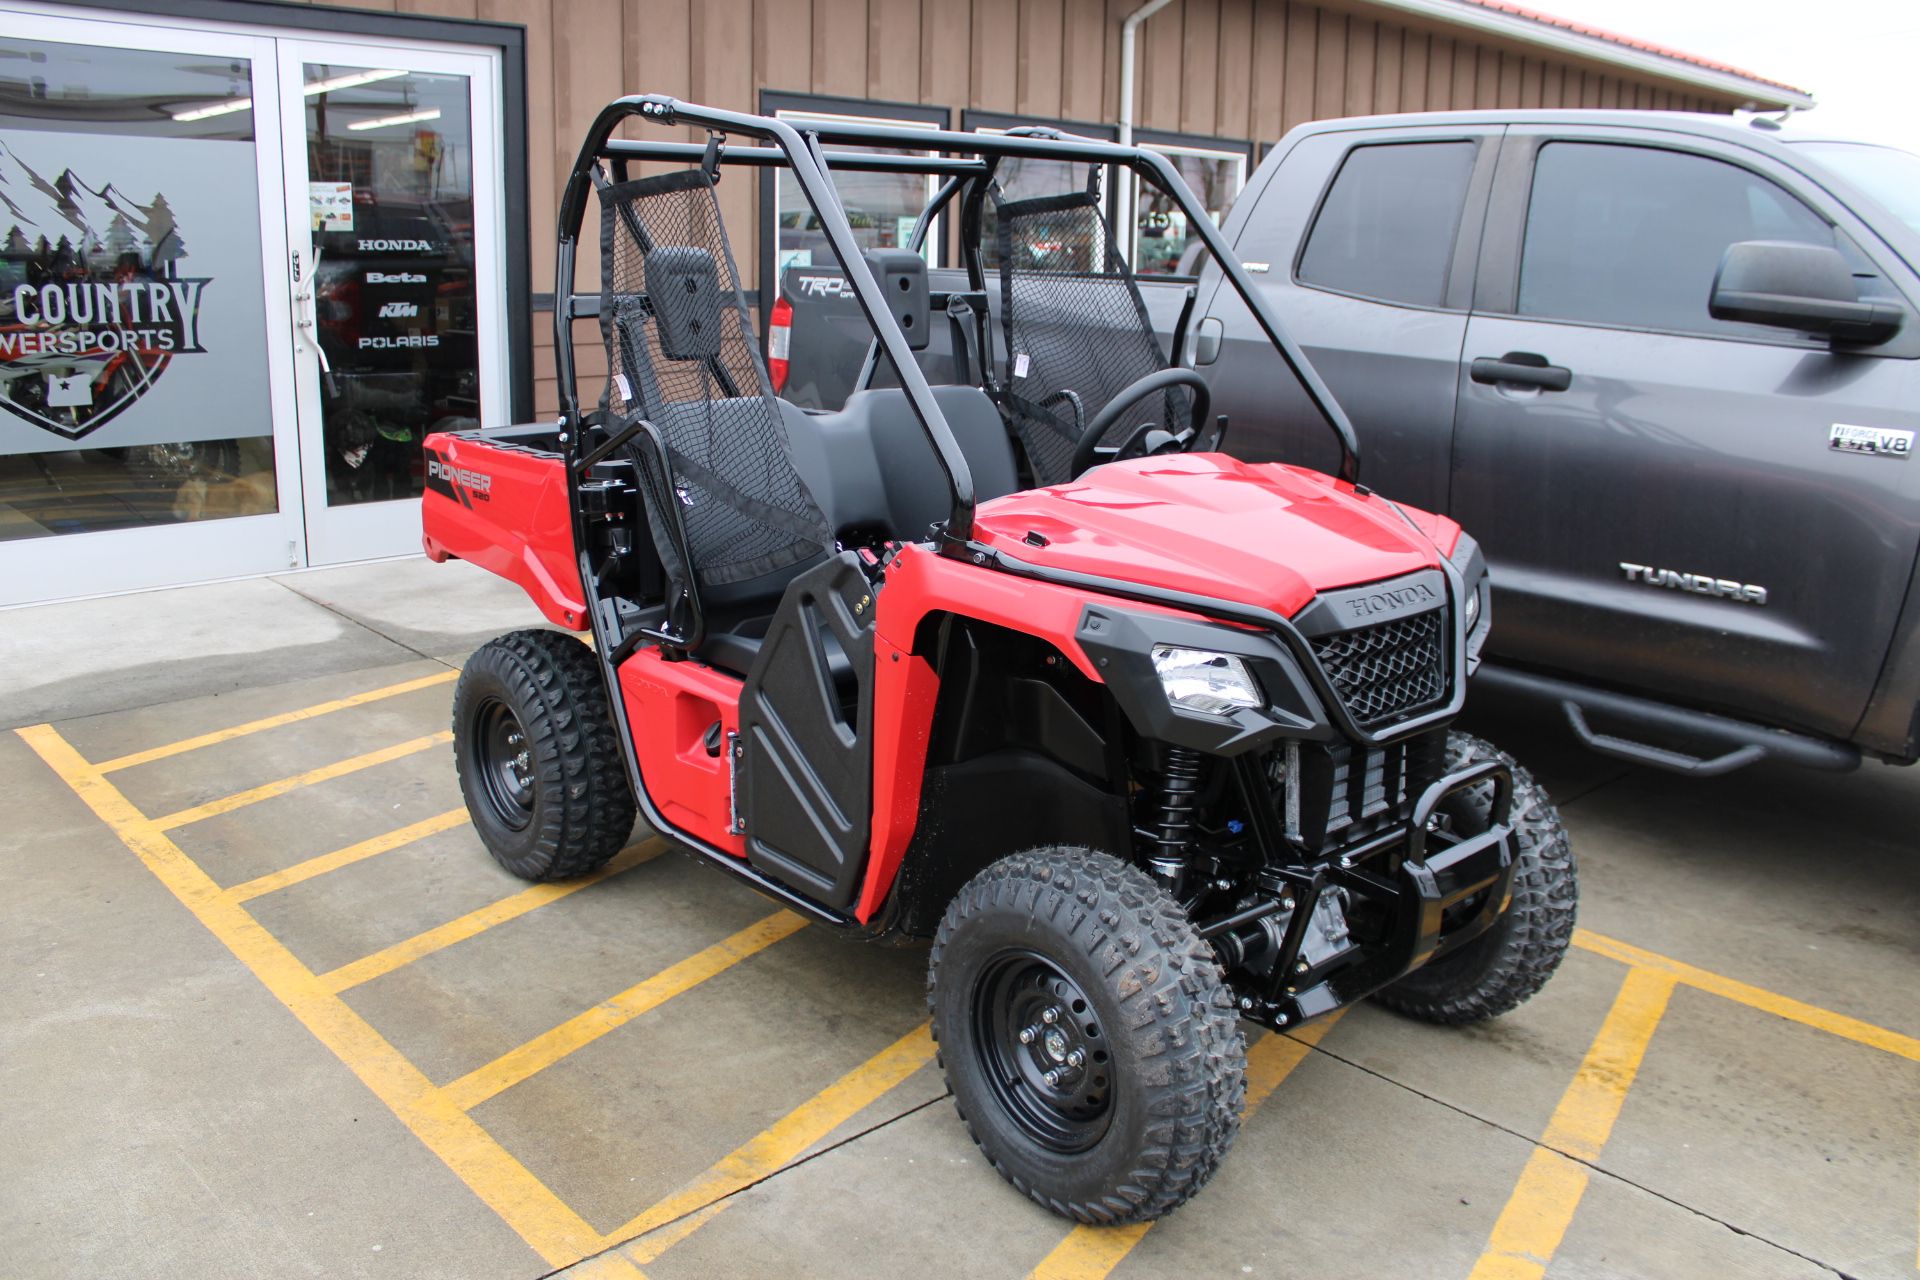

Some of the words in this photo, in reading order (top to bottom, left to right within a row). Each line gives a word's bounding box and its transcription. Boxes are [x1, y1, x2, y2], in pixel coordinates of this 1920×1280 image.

[357, 239, 432, 251] HONDA
[366, 272, 427, 283] Beta
[799, 276, 844, 297] TRD
[14, 281, 201, 350] COUNTRY
[378, 302, 418, 317] KTM
[358, 335, 439, 349] POLARIS
[1881, 435, 1909, 452] V8
[428, 460, 491, 493] PIONEER
[1619, 562, 1767, 605] TUNDRA
[1345, 584, 1437, 618] HONDA
